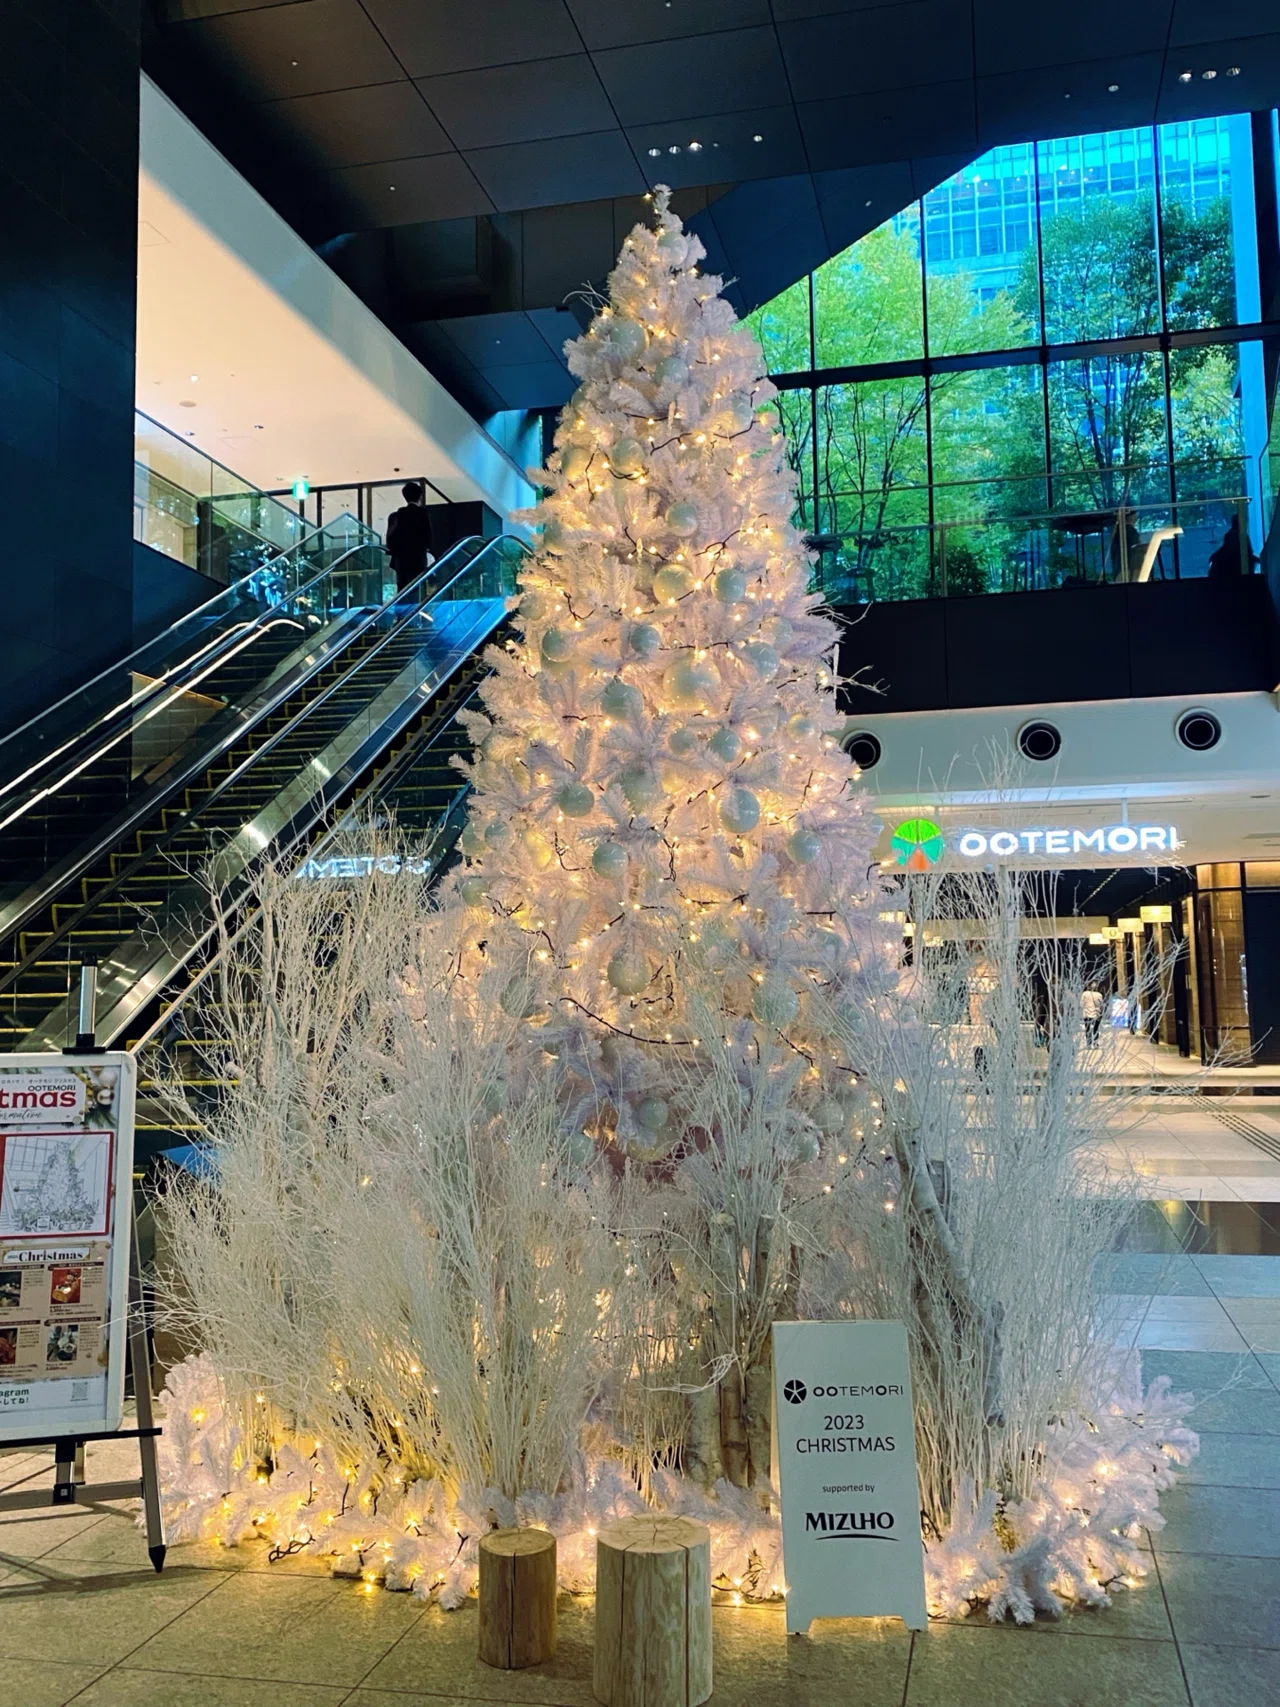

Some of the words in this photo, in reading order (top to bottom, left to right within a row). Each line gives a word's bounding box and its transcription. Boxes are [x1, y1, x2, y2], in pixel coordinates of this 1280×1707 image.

[959, 827, 1177, 857] OOTEMORI
[19, 1250, 83, 1262] Christmas
[813, 1385, 904, 1398] OOTEMORI
[823, 1414, 865, 1431] 2023
[796, 1436, 896, 1453] CHRISTMAS
[822, 1484, 864, 1494] supported
[865, 1484, 876, 1494] by
[805, 1511, 895, 1532] MIZUHO
